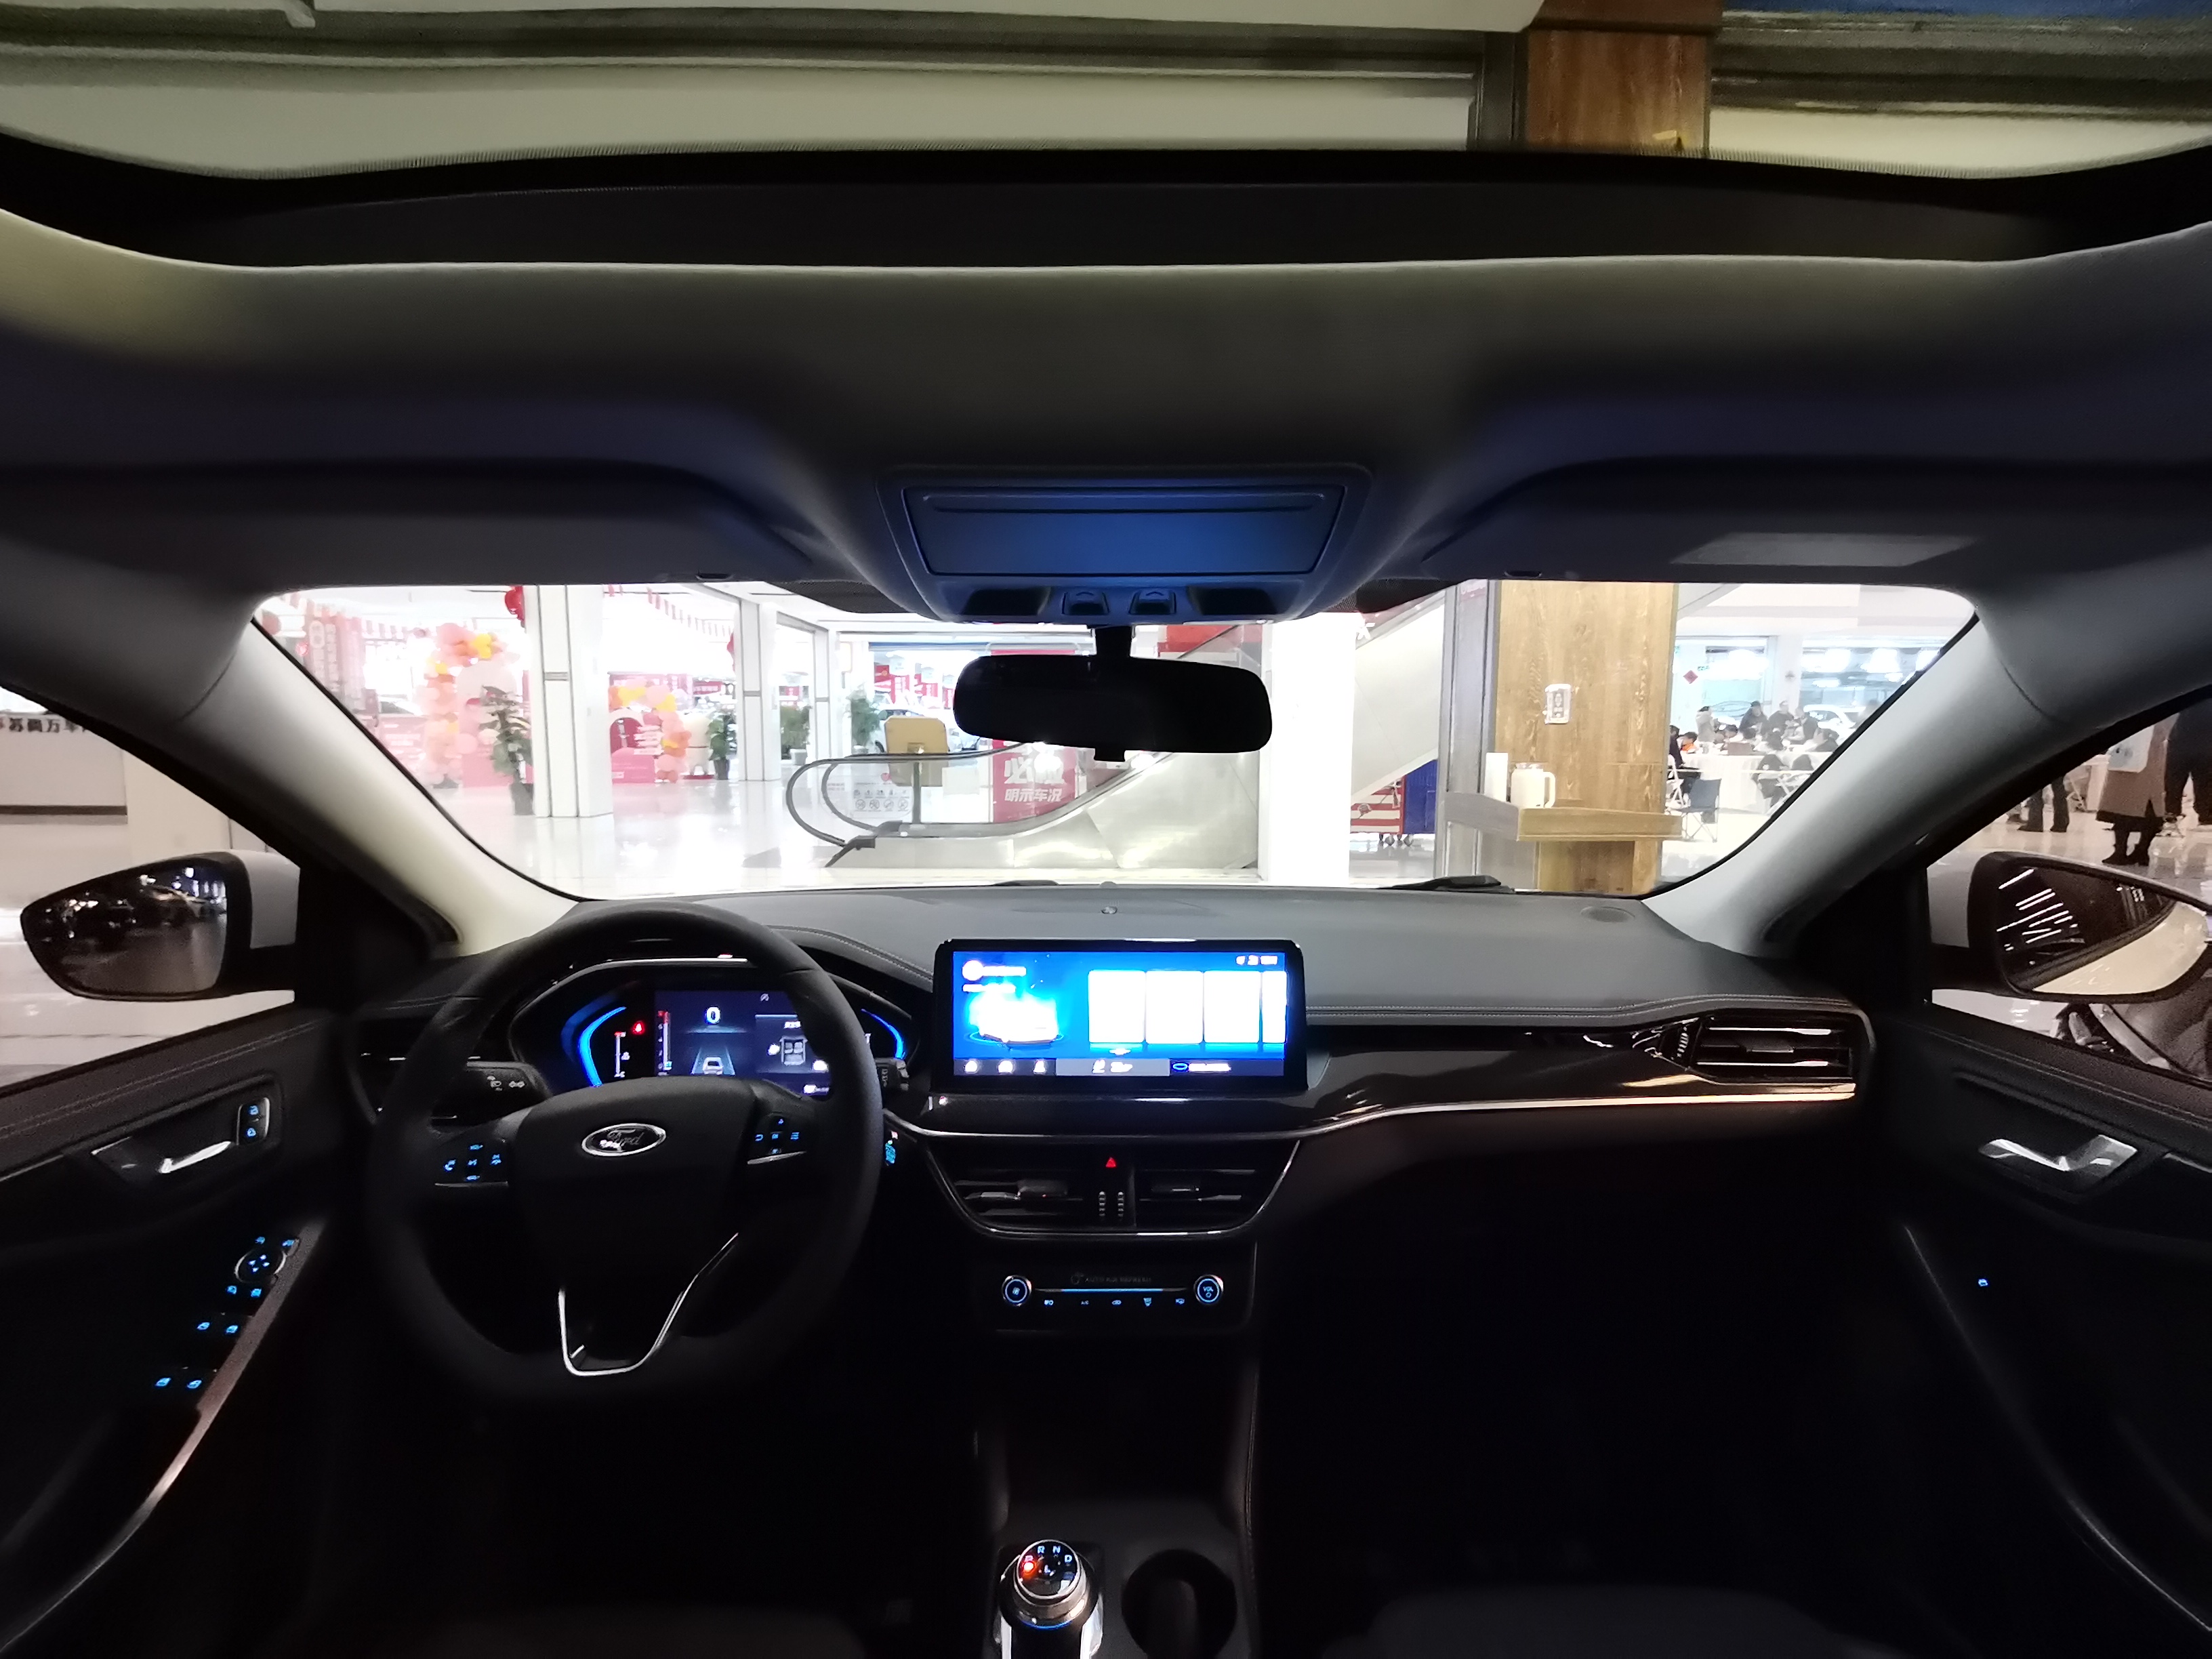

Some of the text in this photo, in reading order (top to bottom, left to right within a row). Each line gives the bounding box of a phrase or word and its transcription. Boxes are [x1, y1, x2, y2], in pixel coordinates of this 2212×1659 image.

[1004, 788, 1063, 802] 明示车况
[705, 1006, 721, 1024] 0
[600, 1128, 644, 1149] Ford
[1037, 1545, 1045, 1554] R
[1052, 1545, 1061, 1554] N
[1064, 1554, 1073, 1563] D
